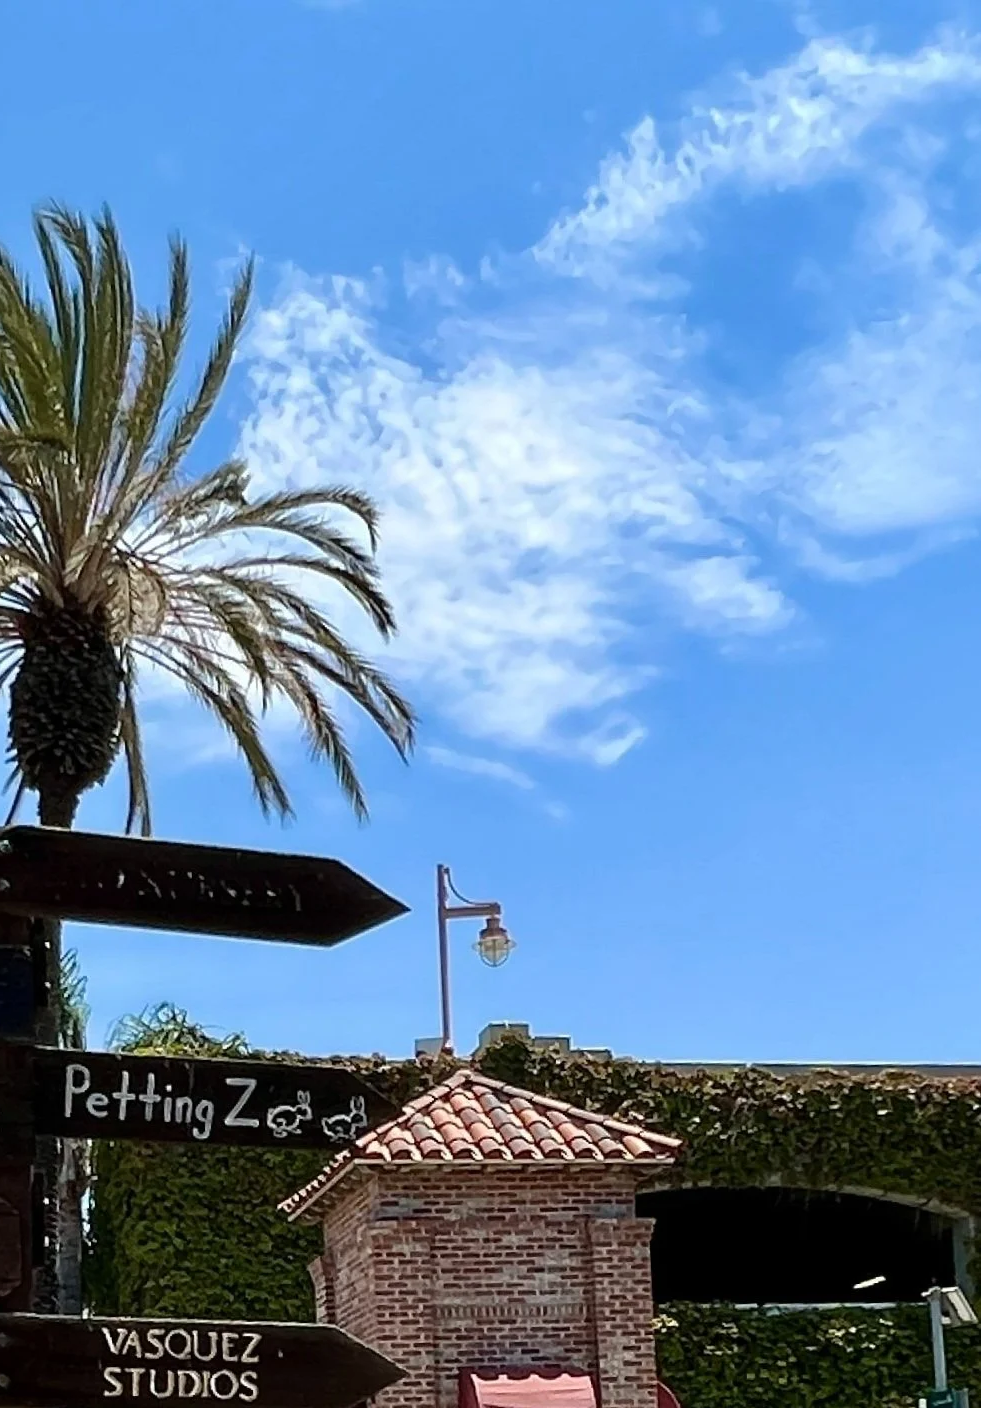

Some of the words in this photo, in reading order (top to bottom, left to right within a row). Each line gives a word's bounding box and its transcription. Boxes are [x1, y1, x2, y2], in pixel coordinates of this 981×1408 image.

[64, 1063, 215, 1139] Petting
[102, 1328, 262, 1363] VASQUEZ
[103, 1367, 259, 1401] STUDIOS
